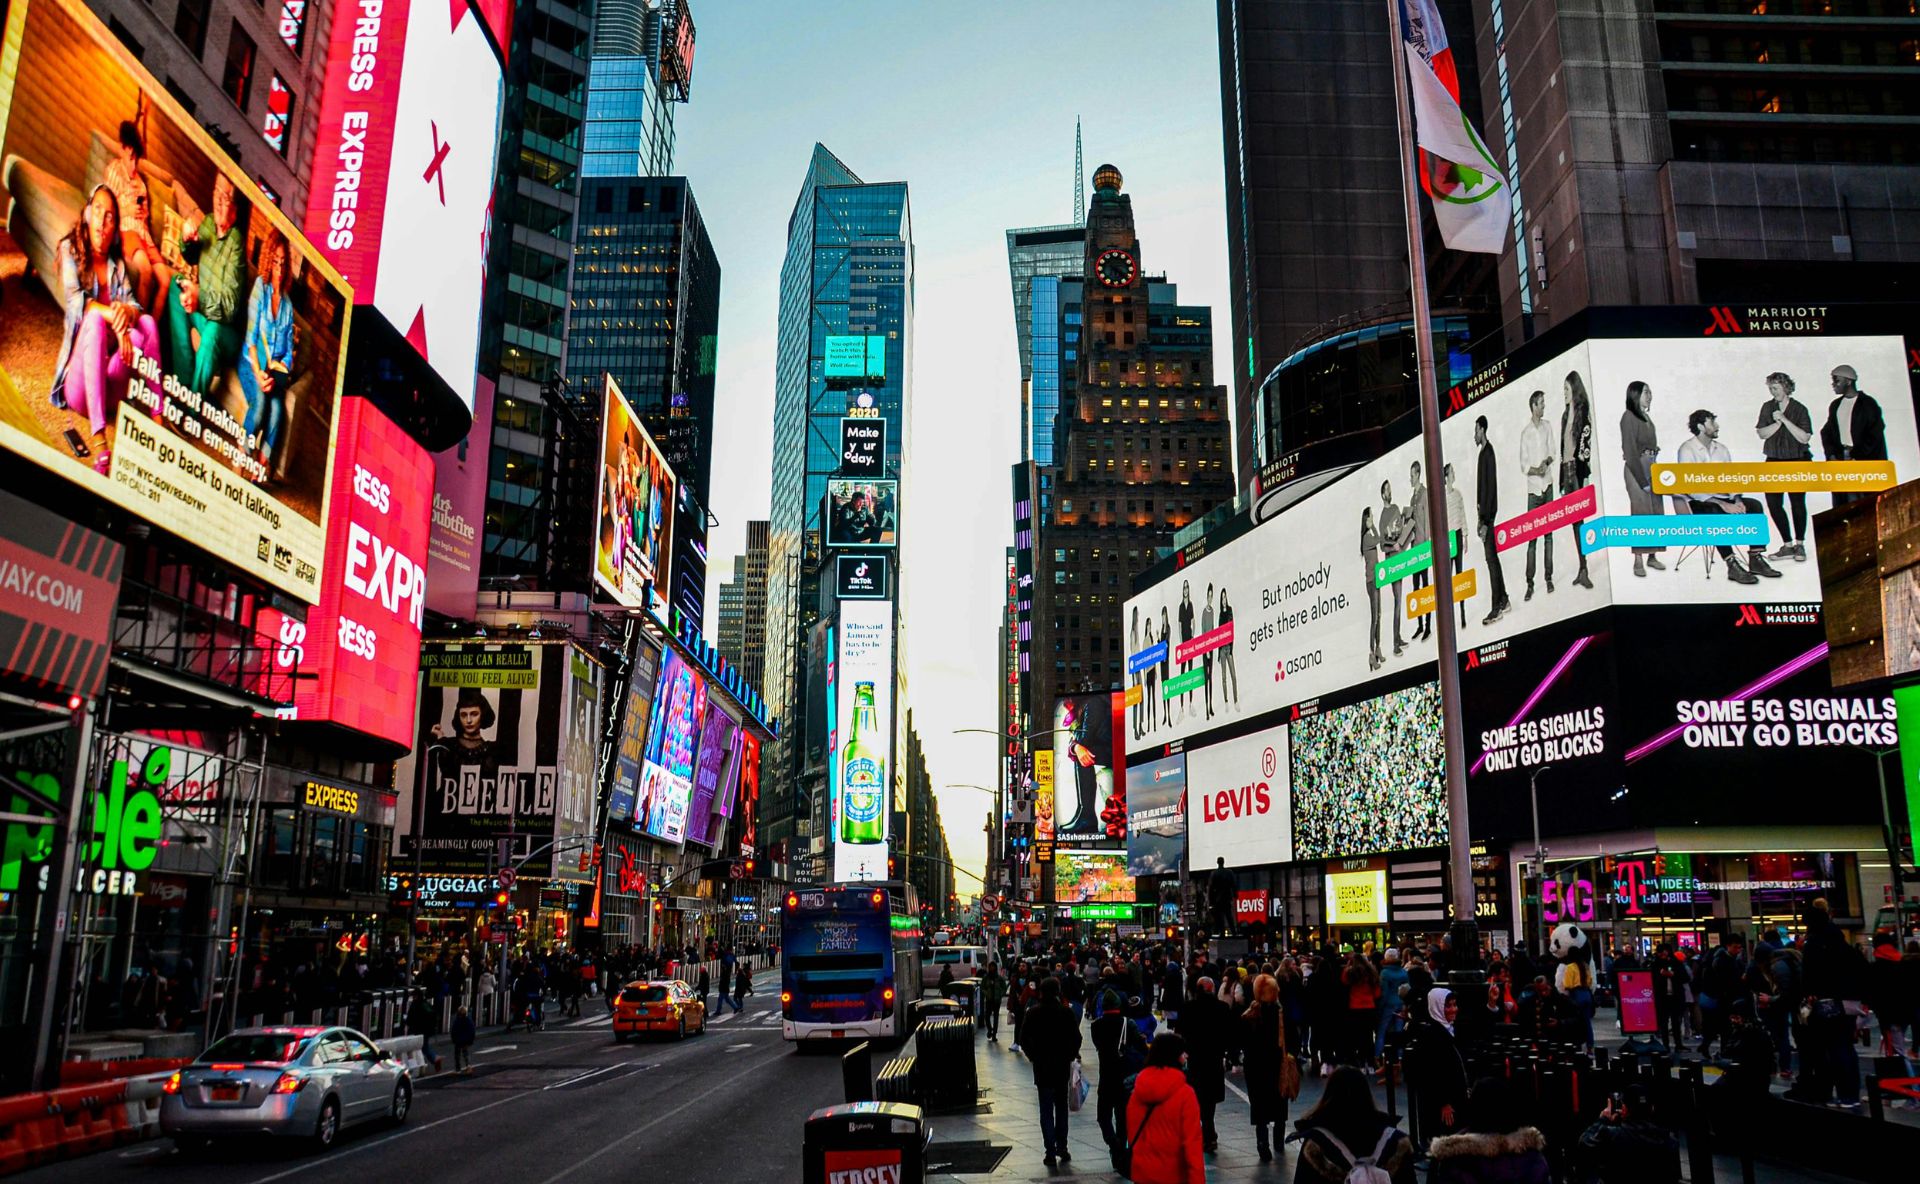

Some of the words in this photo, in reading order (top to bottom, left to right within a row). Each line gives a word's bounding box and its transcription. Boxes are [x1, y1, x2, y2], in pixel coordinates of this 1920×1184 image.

[328, 111, 368, 250] EXPRESS
[1747, 307, 1828, 318] MARRIOTT
[1750, 320, 1821, 331] MARQUIS
[1466, 358, 1509, 390] MARRIOTT
[1467, 373, 1505, 401] MARQUIS
[132, 346, 161, 381] Talk
[163, 372, 201, 411] about
[202, 402, 247, 444] making
[247, 434, 256, 450] a
[849, 408, 879, 418] 2020
[128, 377, 161, 412] plan
[162, 402, 183, 420] for
[183, 415, 201, 438] an
[202, 429, 267, 482] emergency.
[847, 427, 879, 438] Make
[850, 453, 875, 466] day.
[1262, 452, 1300, 478] MARRIOTT
[118, 455, 137, 472] VISIT
[136, 466, 207, 513] NYC.GOV/READYNY
[123, 416, 156, 452] Then
[160, 442, 176, 463] go
[178, 449, 208, 484] back
[211, 470, 222, 492] to
[224, 483, 244, 505] not
[244, 491, 282, 530] talking.
[1263, 467, 1296, 490] MARQUIS
[1683, 473, 1715, 483] Make
[1717, 472, 1756, 486] design
[1758, 471, 1818, 482] accessible
[1820, 472, 1832, 482] to
[1834, 472, 1888, 485] everyone
[116, 472, 129, 486] OR
[128, 478, 148, 496] CALL
[148, 488, 161, 504] 311
[1510, 525, 1522, 538] Sell
[1522, 522, 1533, 533] tile
[1533, 516, 1547, 528] that
[1547, 509, 1565, 522] lasts
[1564, 498, 1591, 515] forever
[1600, 525, 1629, 536] Write
[1631, 527, 1656, 536] new
[1658, 524, 1704, 538] product
[1706, 526, 1734, 537] spec
[1736, 524, 1758, 535] doc
[1262, 588, 1282, 610] But
[1284, 562, 1332, 605] nobody
[1765, 605, 1822, 614] MARRIOTT
[1765, 614, 1817, 625] MARQUIS
[1249, 626, 1274, 652] gets
[1277, 610, 1308, 636] there
[1310, 595, 1350, 626] alone.
[440, 653, 473, 668] SQUARE
[476, 653, 493, 666] CAN
[496, 653, 529, 666] REALLY
[1480, 640, 1509, 655] MARRIOTT
[1480, 650, 1507, 664] MARQUIS
[1286, 649, 1323, 675] asana
[433, 672, 459, 684] MAKE
[462, 672, 479, 684] YOU
[481, 672, 504, 685] FEEL
[506, 673, 535, 685] ALIVE!
[1677, 700, 1746, 724] SOME
[1751, 699, 1783, 723] 5G
[1789, 698, 1898, 723] SIGNALS
[1481, 725, 1517, 752] SOME
[1519, 721, 1538, 743] 5G
[1540, 706, 1605, 738] SIGNALS
[1683, 724, 1748, 748] ONLY
[1752, 724, 1792, 747] GO
[1796, 722, 1899, 746] BLOCKS
[1485, 748, 1518, 772] ONLY
[1521, 743, 1543, 765] GO
[1544, 731, 1604, 761] BLOCKS
[306, 782, 358, 814] EXPRESS
[441, 771, 554, 815] BEETLE
[1057, 833, 1107, 841] SASshoes.com
[1340, 900, 1371, 914] HOLIDAYS
[1543, 880, 1593, 922] 5G
[821, 942, 852, 950] FAMILY
